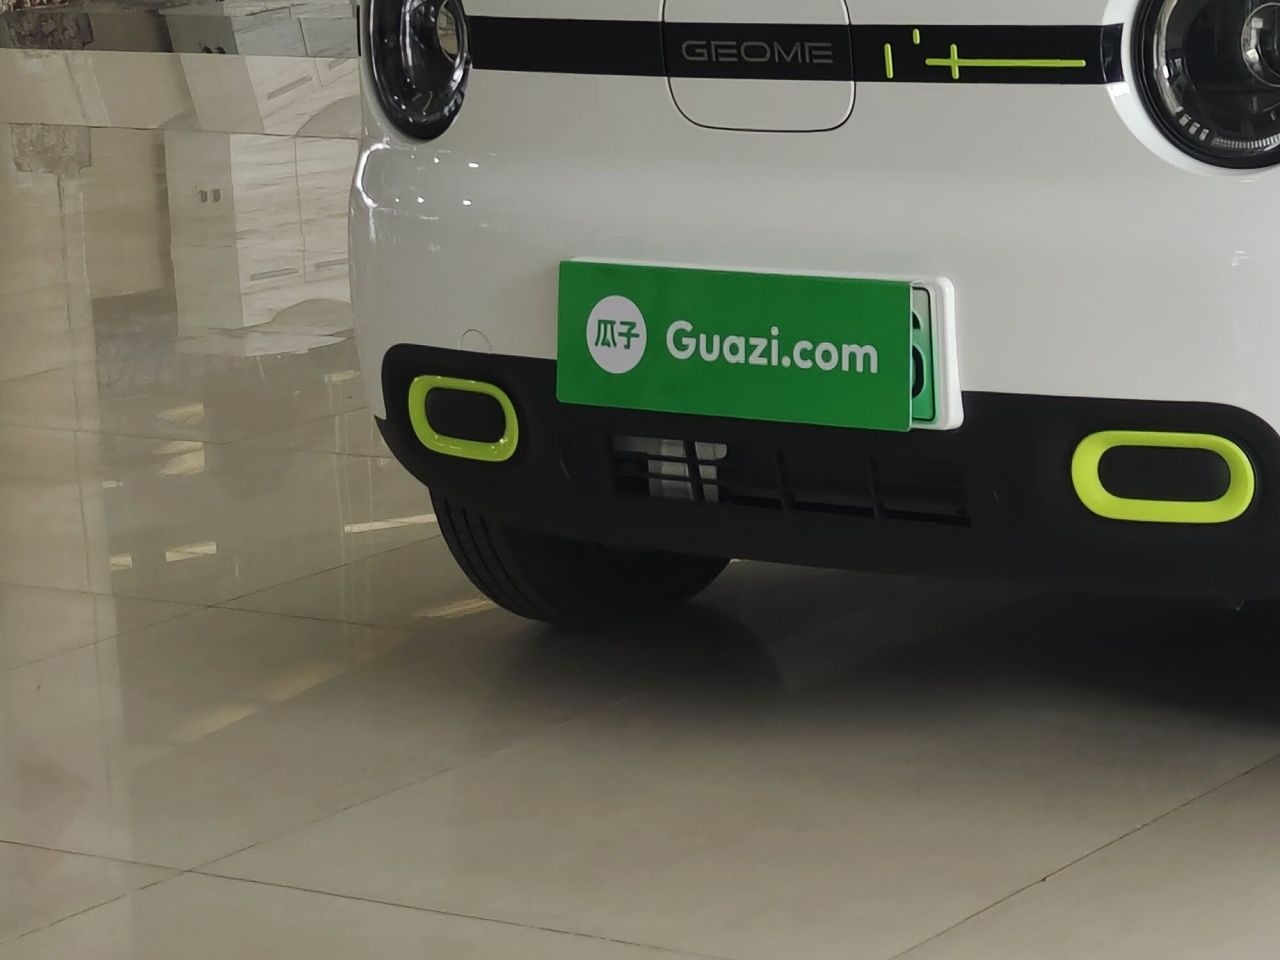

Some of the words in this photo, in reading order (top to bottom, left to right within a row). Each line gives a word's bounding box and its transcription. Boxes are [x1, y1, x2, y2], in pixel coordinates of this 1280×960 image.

[681, 40, 834, 64] GEOME
[594, 318, 640, 350] 瓜子
[665, 319, 879, 375] Guazi.com
